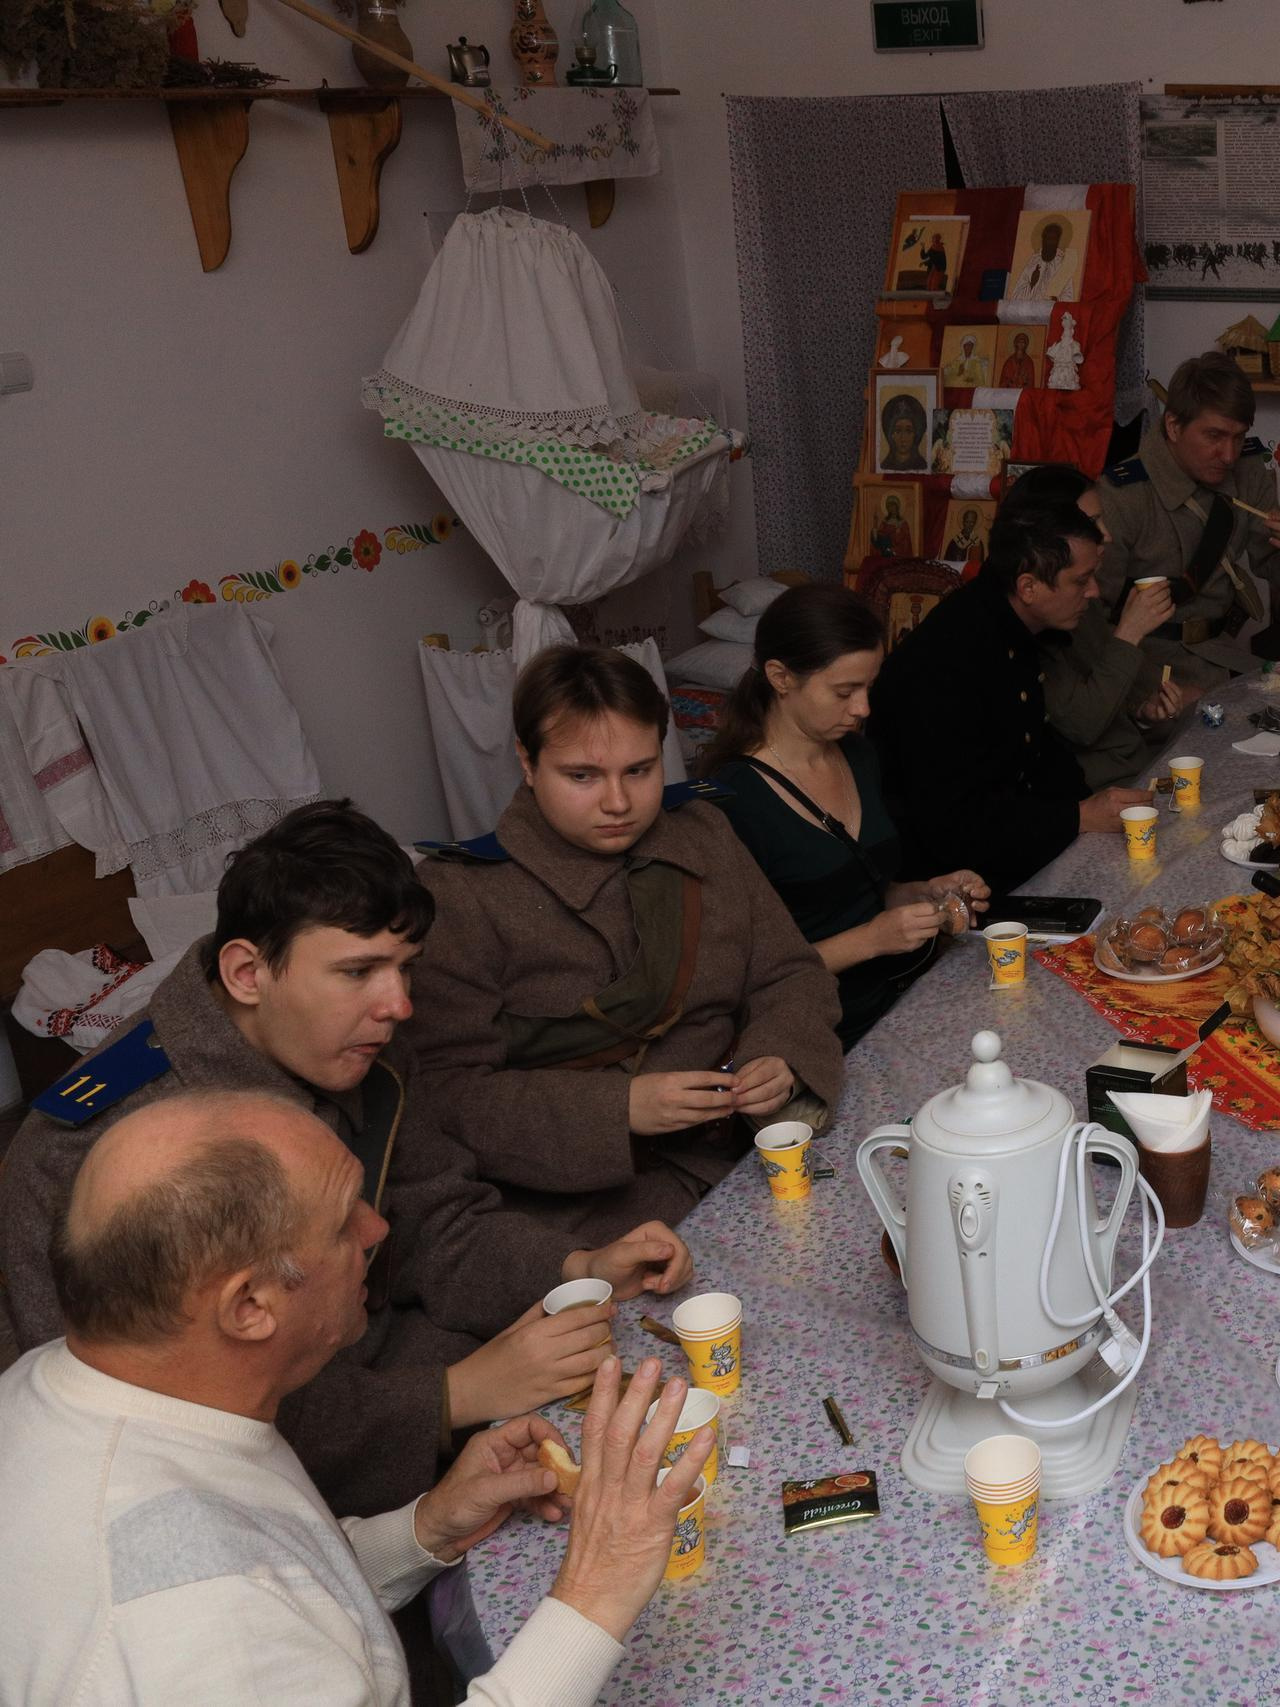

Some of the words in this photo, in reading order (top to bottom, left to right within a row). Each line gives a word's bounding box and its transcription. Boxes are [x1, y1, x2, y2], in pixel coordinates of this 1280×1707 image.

[901, 6, 951, 26] ВЫХОД
[912, 28, 942, 42] EXIT
[803, 1499, 862, 1521] Greenfield
